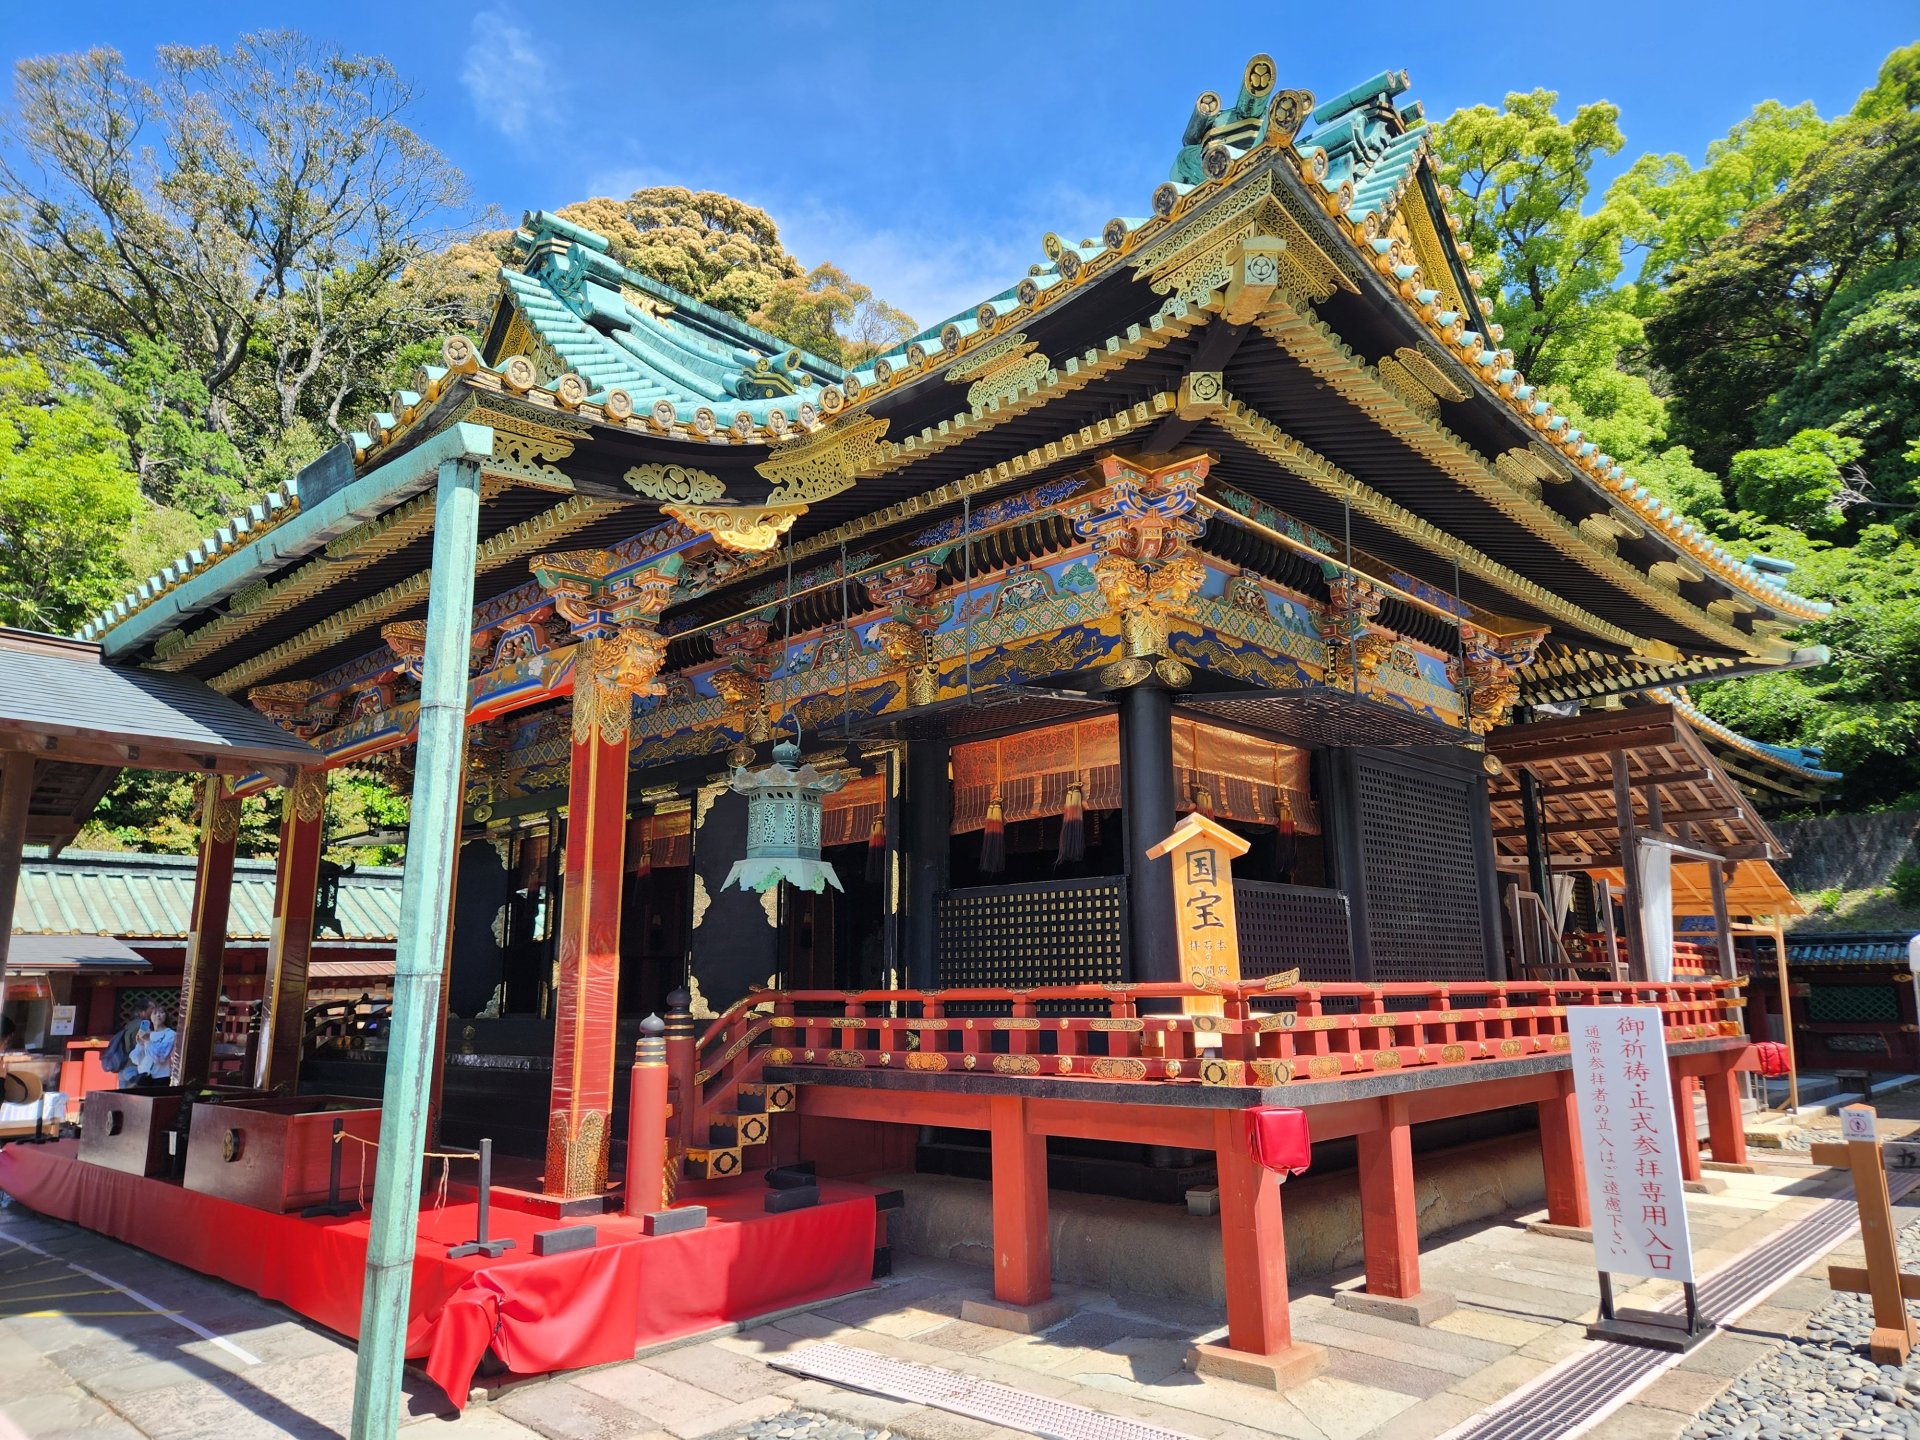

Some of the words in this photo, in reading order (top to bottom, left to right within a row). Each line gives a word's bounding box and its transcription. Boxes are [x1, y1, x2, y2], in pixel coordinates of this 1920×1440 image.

[1186, 848, 1225, 931] 国宝
[1584, 1025, 1627, 1256] 通常参拝者の立入はご遠慮下さい
[1616, 1016, 1674, 1271] 御祈祷・正式参拝専用入口
